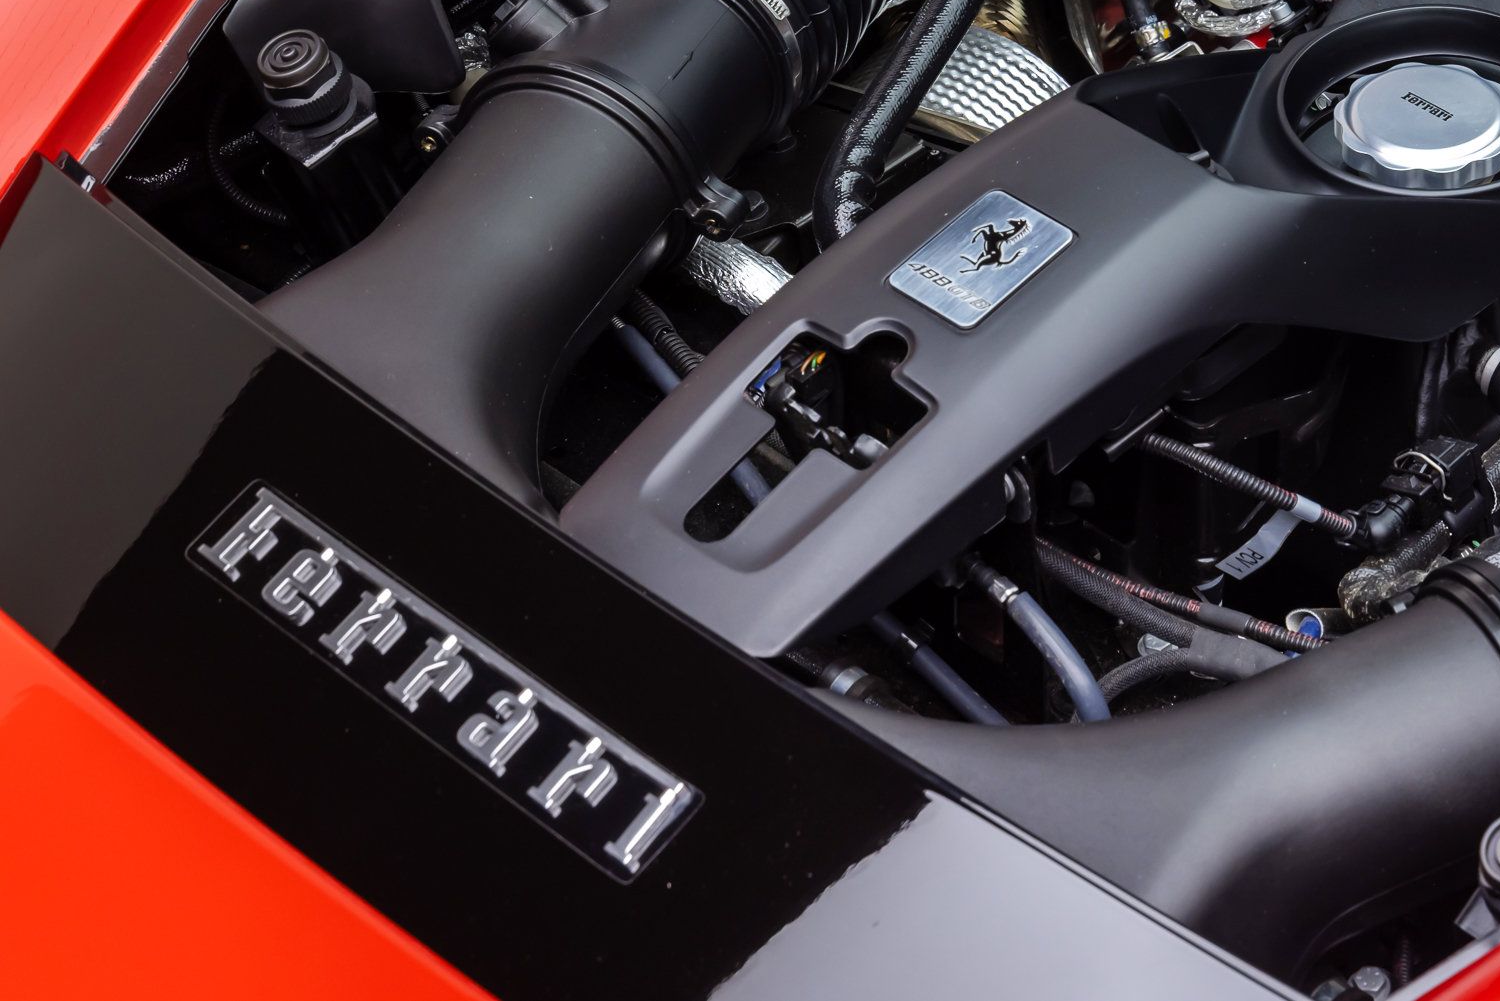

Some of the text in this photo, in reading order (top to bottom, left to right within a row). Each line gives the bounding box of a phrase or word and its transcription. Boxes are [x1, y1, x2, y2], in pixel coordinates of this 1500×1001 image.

[1401, 92, 1454, 122] Ferrari
[907, 262, 953, 287] 488
[198, 488, 694, 873] Ferrari
